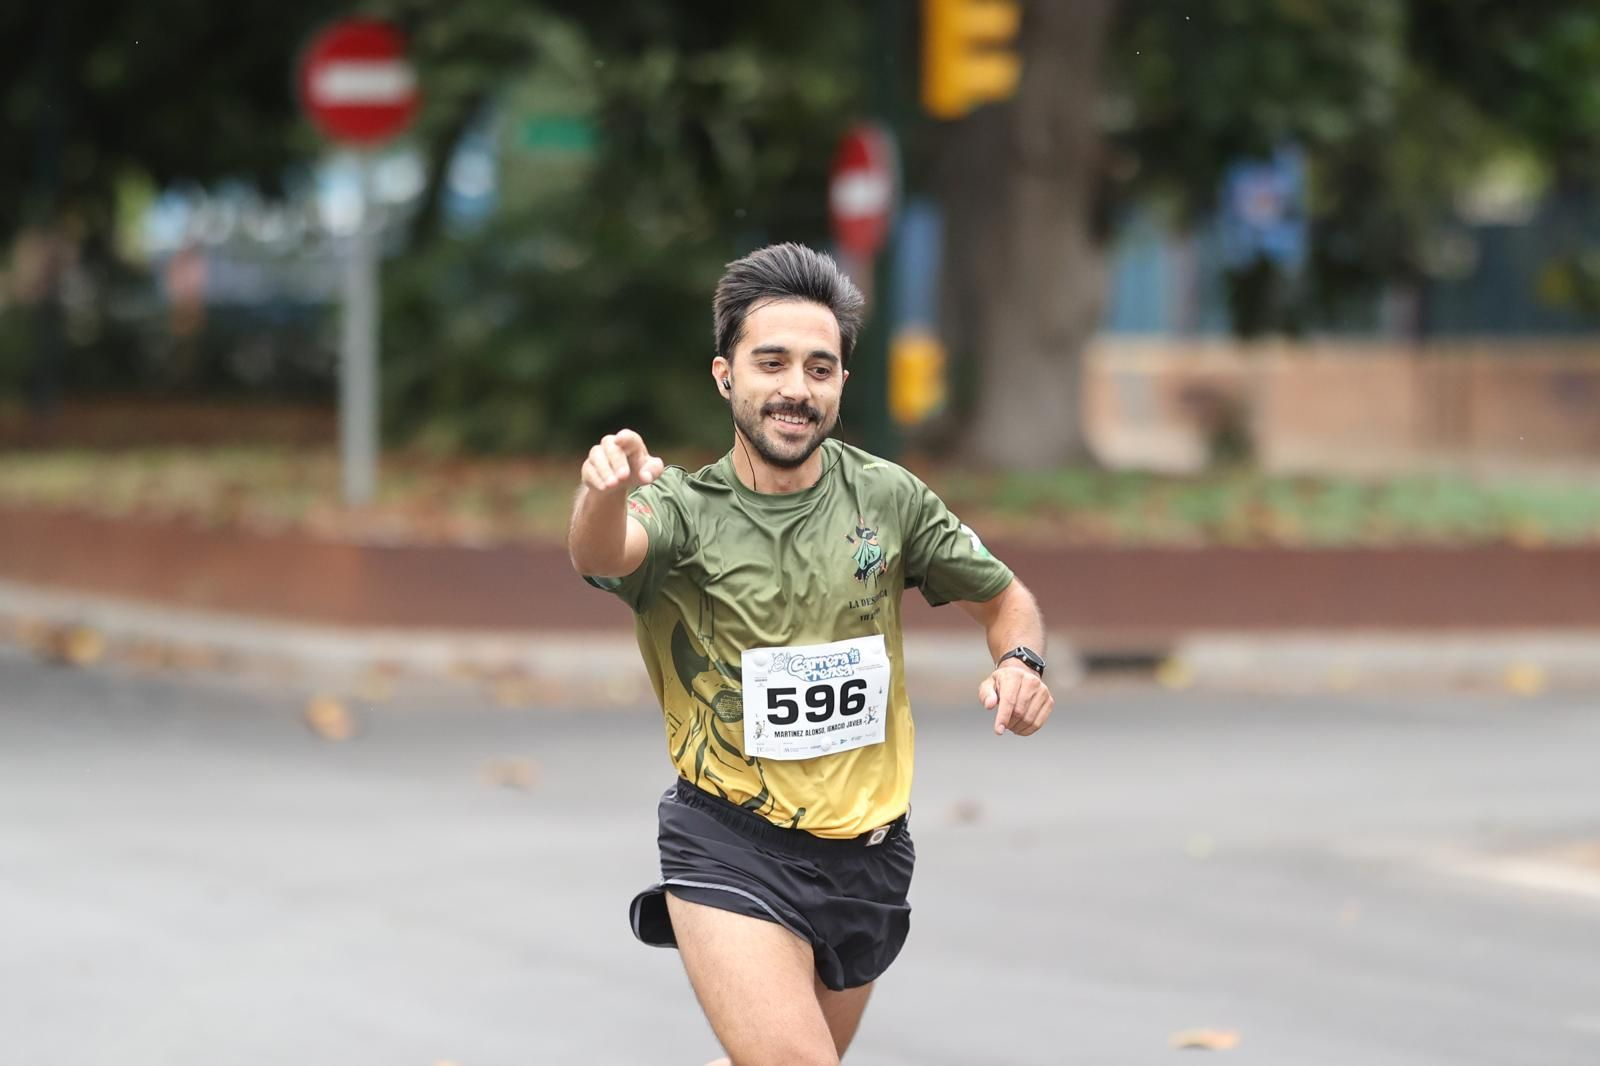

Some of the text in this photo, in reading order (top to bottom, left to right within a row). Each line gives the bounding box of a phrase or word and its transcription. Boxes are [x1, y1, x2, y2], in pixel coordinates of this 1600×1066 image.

[788, 652, 850, 673] Carrera
[804, 664, 855, 681] Prensa
[767, 678, 867, 726] 596
[774, 730, 804, 738] MARTINEZ
[826, 722, 846, 732] IGNACIO
[846, 718, 863, 728] JAVIER
